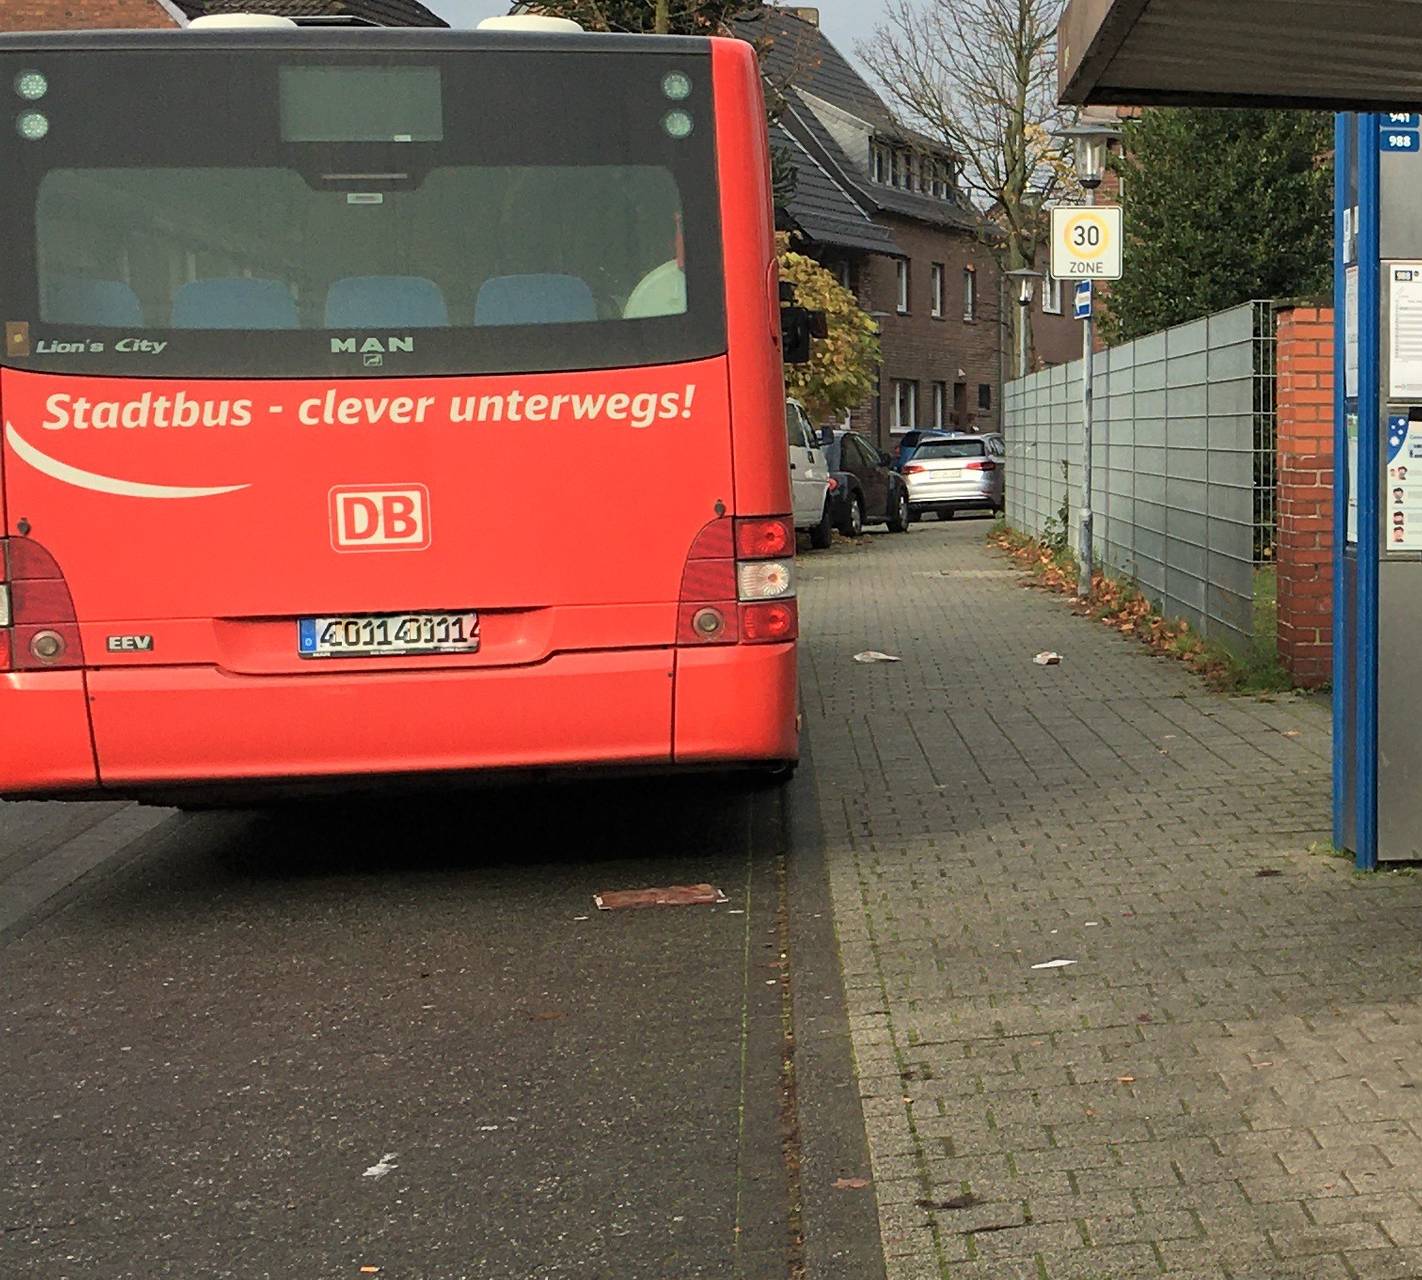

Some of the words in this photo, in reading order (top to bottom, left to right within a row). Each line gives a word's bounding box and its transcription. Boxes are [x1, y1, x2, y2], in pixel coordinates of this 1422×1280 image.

[1388, 135, 1412, 147] 988
[1073, 225, 1100, 246] 30
[1069, 261, 1104, 274] ZONE
[36, 337, 104, 354] Lion's
[114, 337, 168, 355] City
[329, 336, 415, 354] MAN
[42, 389, 253, 431] Stadtbus
[297, 387, 435, 426] clever
[449, 383, 697, 429] unterwegs!
[341, 493, 420, 542] DB
[108, 635, 151, 650] EEV
